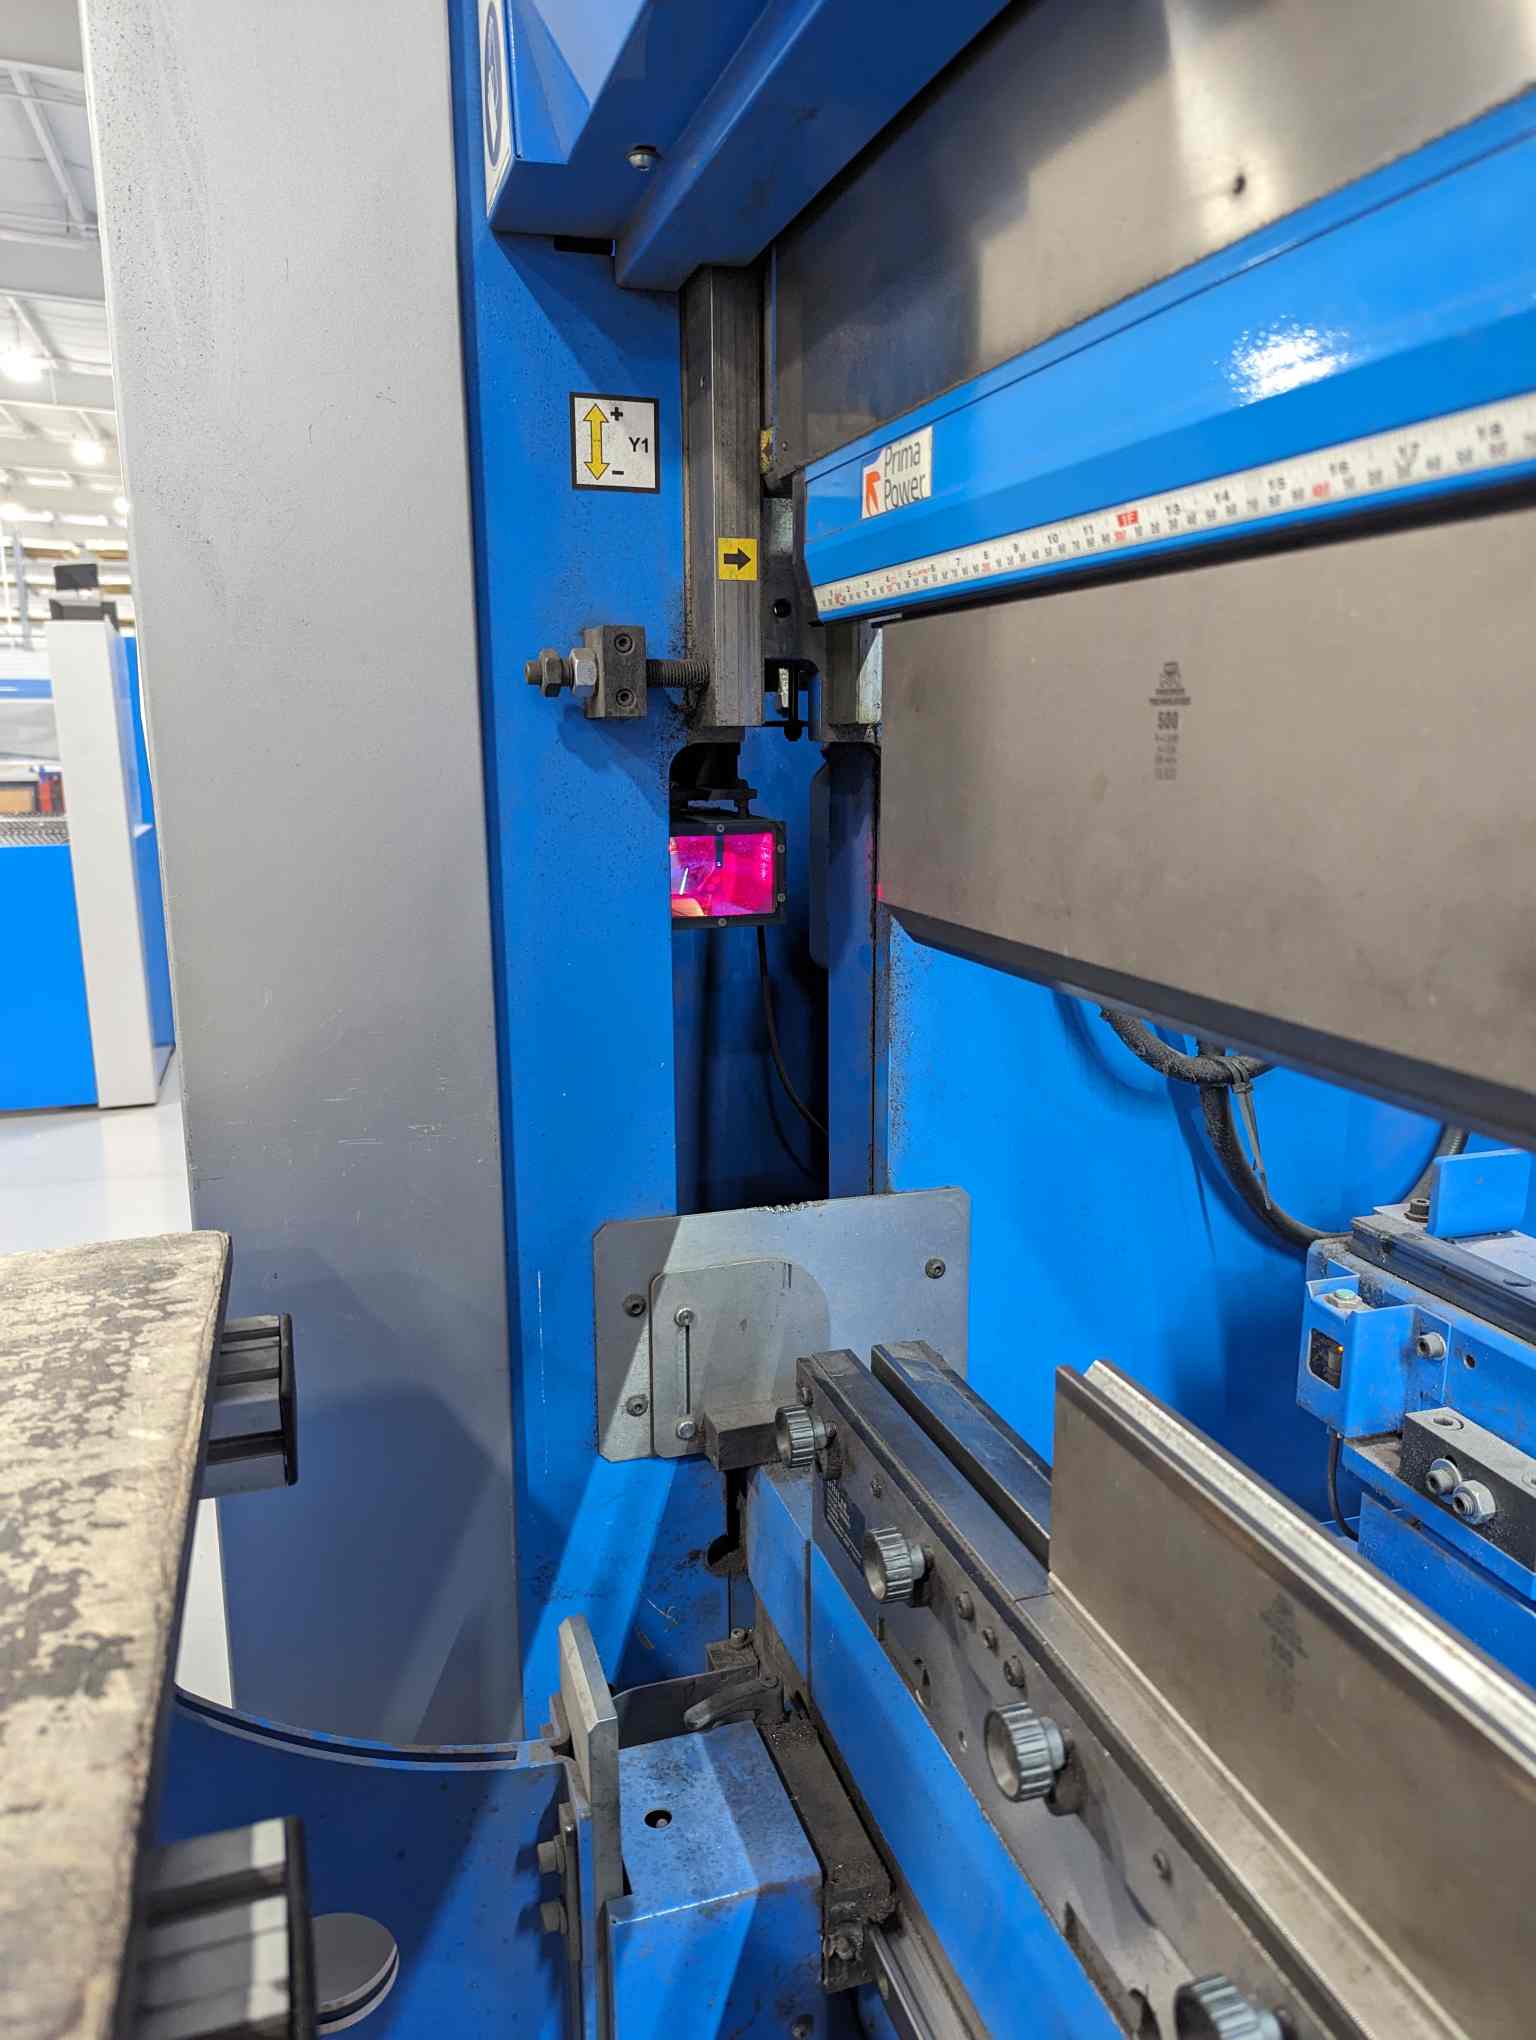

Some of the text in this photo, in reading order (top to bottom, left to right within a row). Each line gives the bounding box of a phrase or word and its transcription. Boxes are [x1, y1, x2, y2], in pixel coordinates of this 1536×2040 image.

[628, 437, 649, 453] Y1
[885, 440, 921, 477] Prima
[885, 474, 926, 510] Power
[1047, 532, 1060, 544] 10
